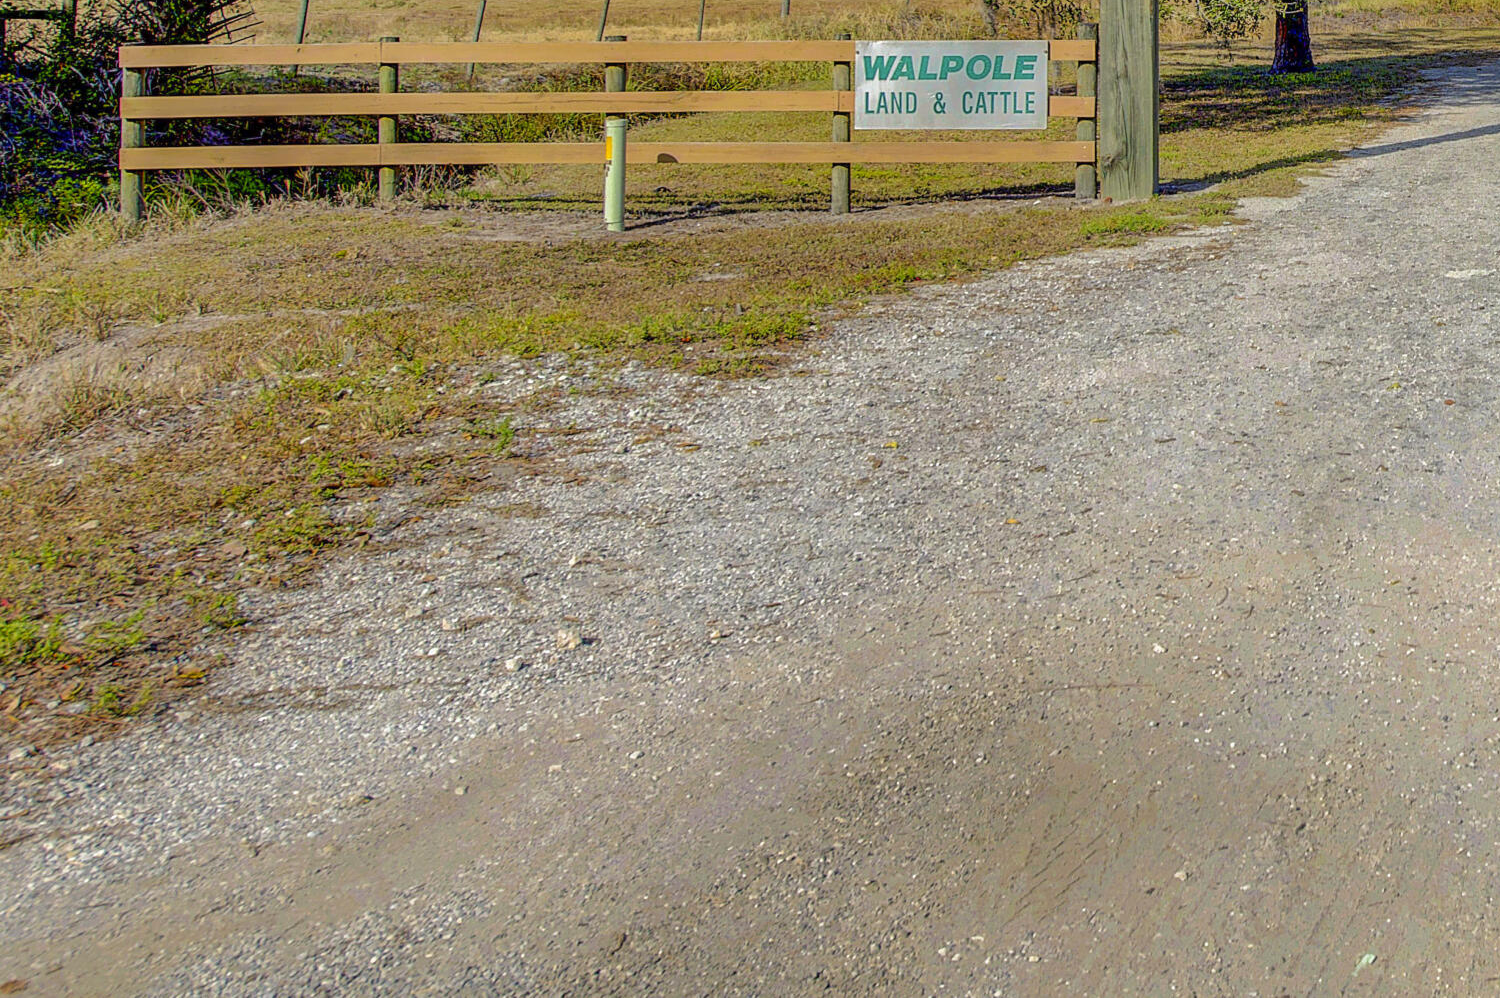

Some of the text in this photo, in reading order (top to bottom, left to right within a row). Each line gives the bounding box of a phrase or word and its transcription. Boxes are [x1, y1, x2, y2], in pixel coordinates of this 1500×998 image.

[863, 54, 1038, 80] WALPOLE
[864, 91, 1036, 115] LAND & CATTLE
